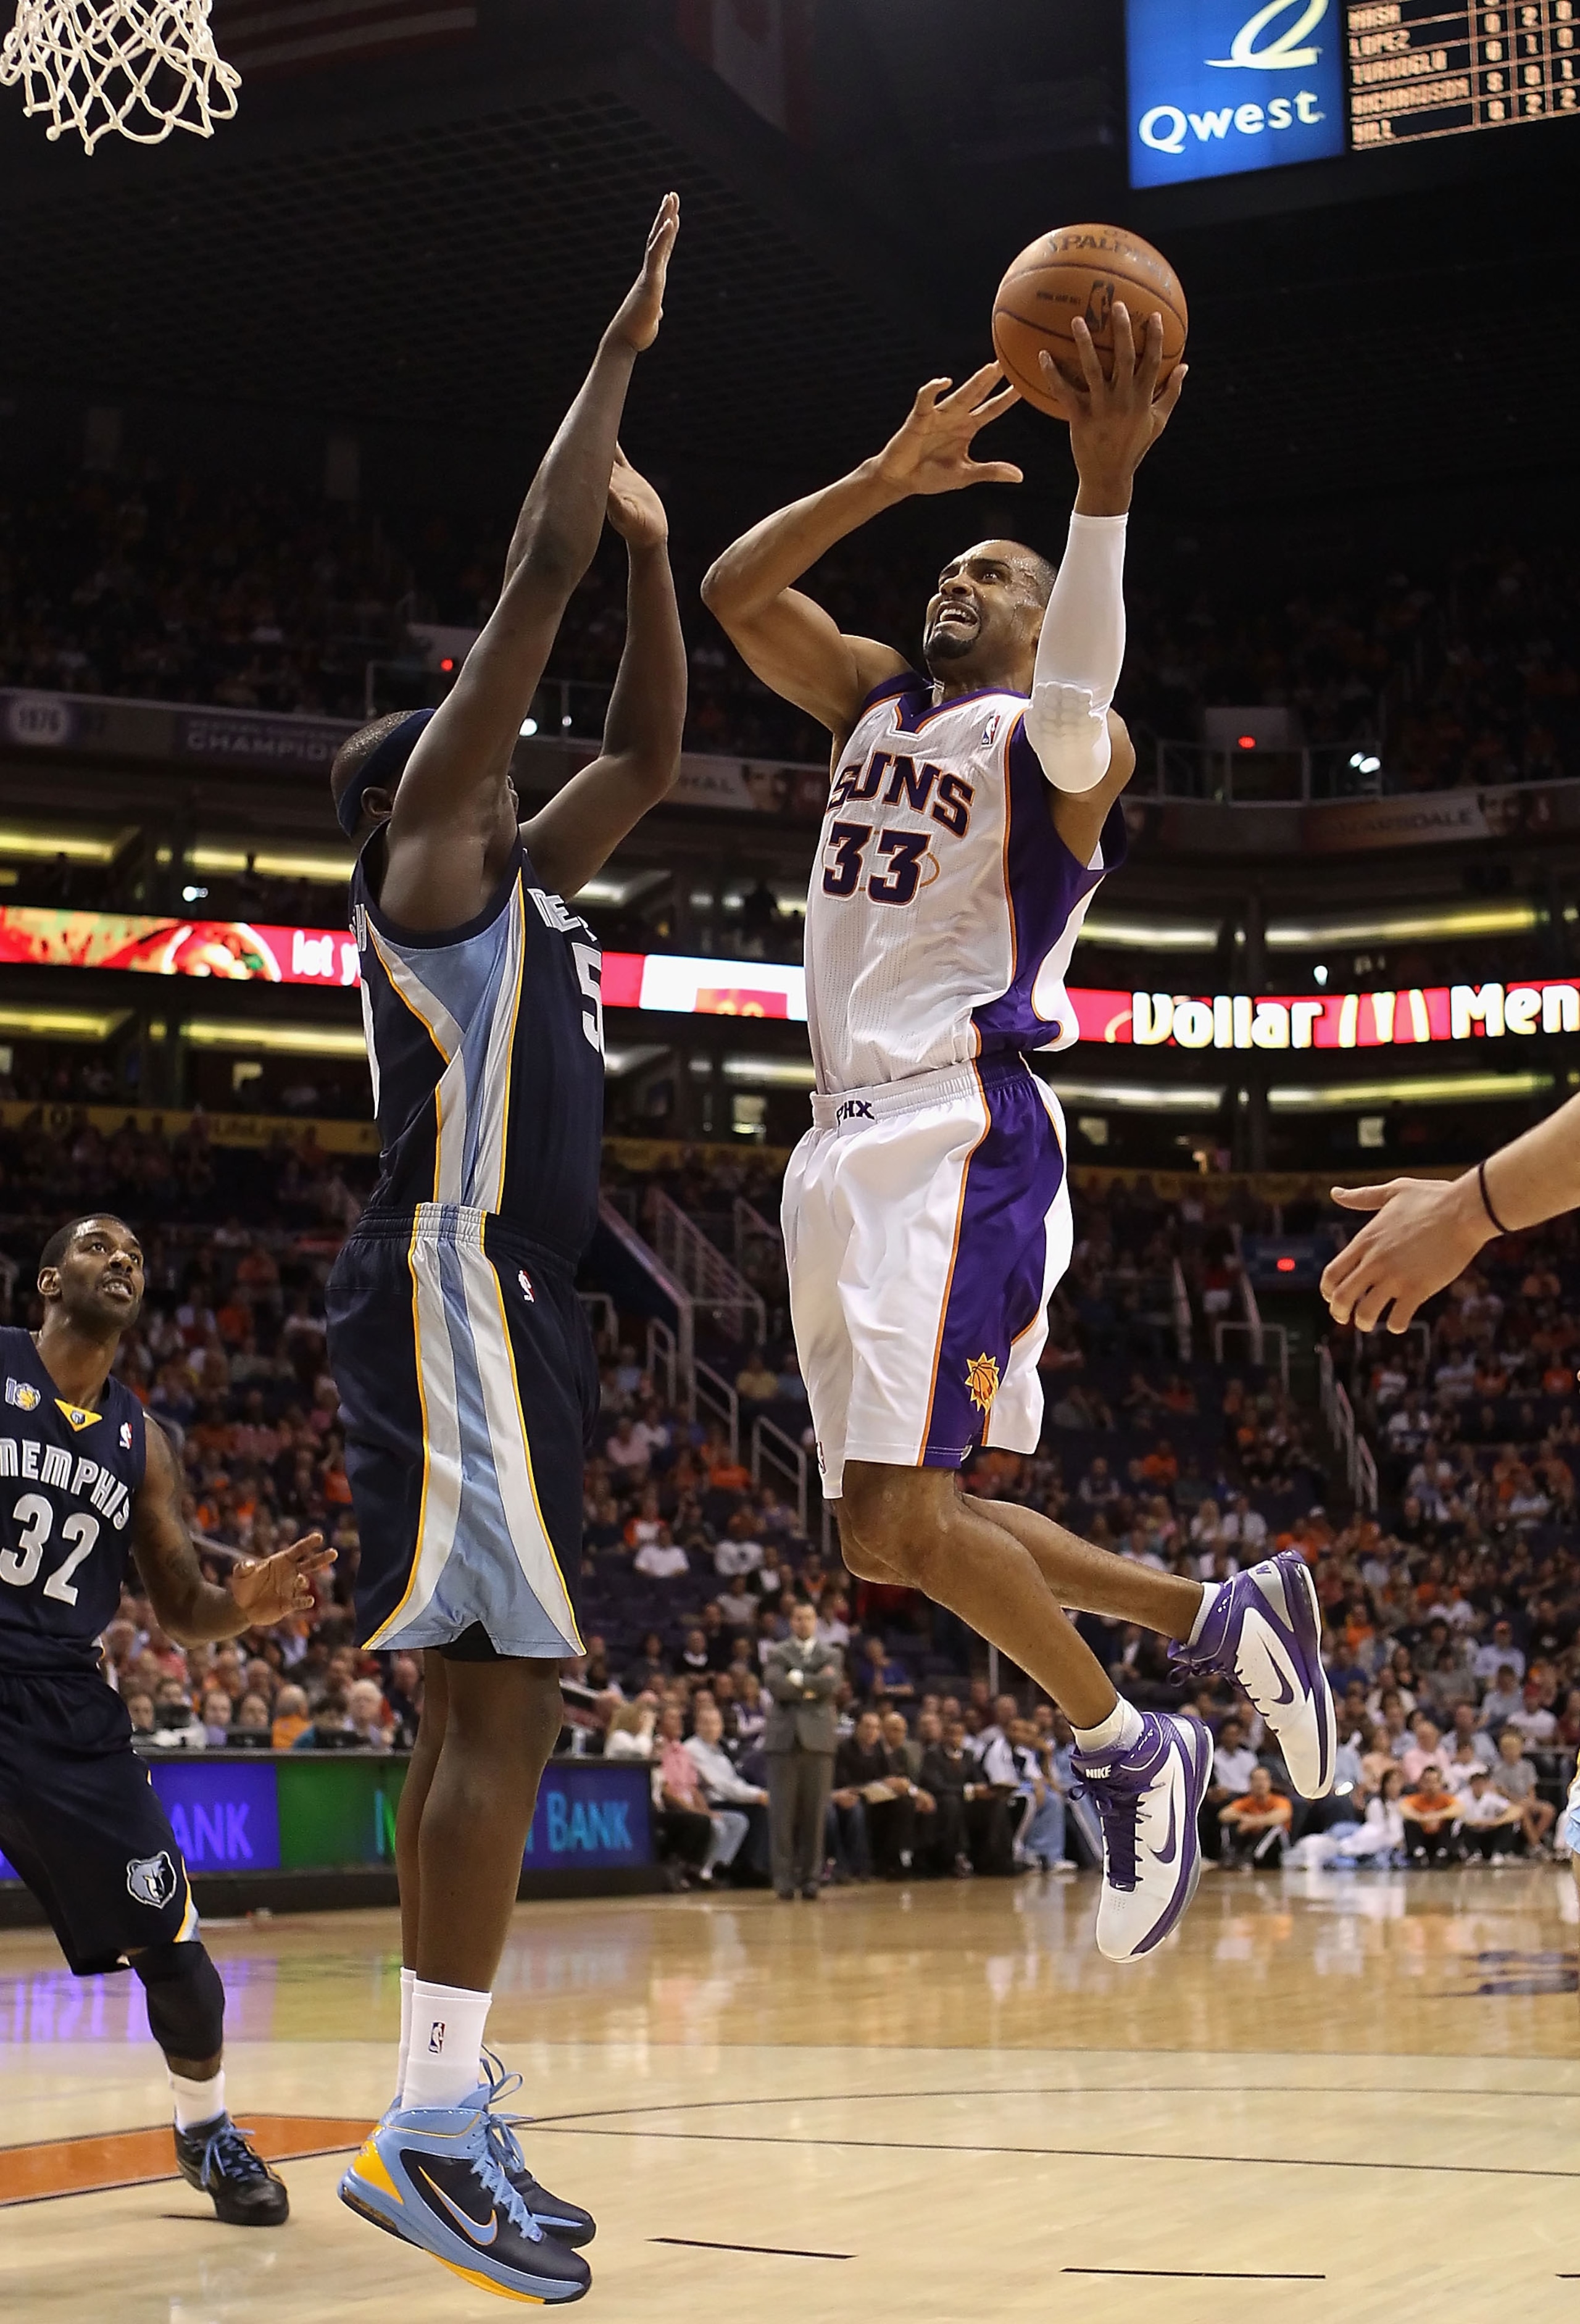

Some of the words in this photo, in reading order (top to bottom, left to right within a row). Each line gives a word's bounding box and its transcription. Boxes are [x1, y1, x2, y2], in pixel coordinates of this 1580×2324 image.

[1138, 91, 1324, 154] Qwest
[827, 751, 975, 838] SUNS
[821, 821, 931, 908] 33
[1133, 992, 1323, 1049] Dollar
[836, 1100, 875, 1128] PHX
[0, 1493, 99, 1607] 32
[1085, 1764, 1112, 1779] NIKE
[170, 1801, 254, 1861] ANK
[547, 1791, 633, 1852] BANK
